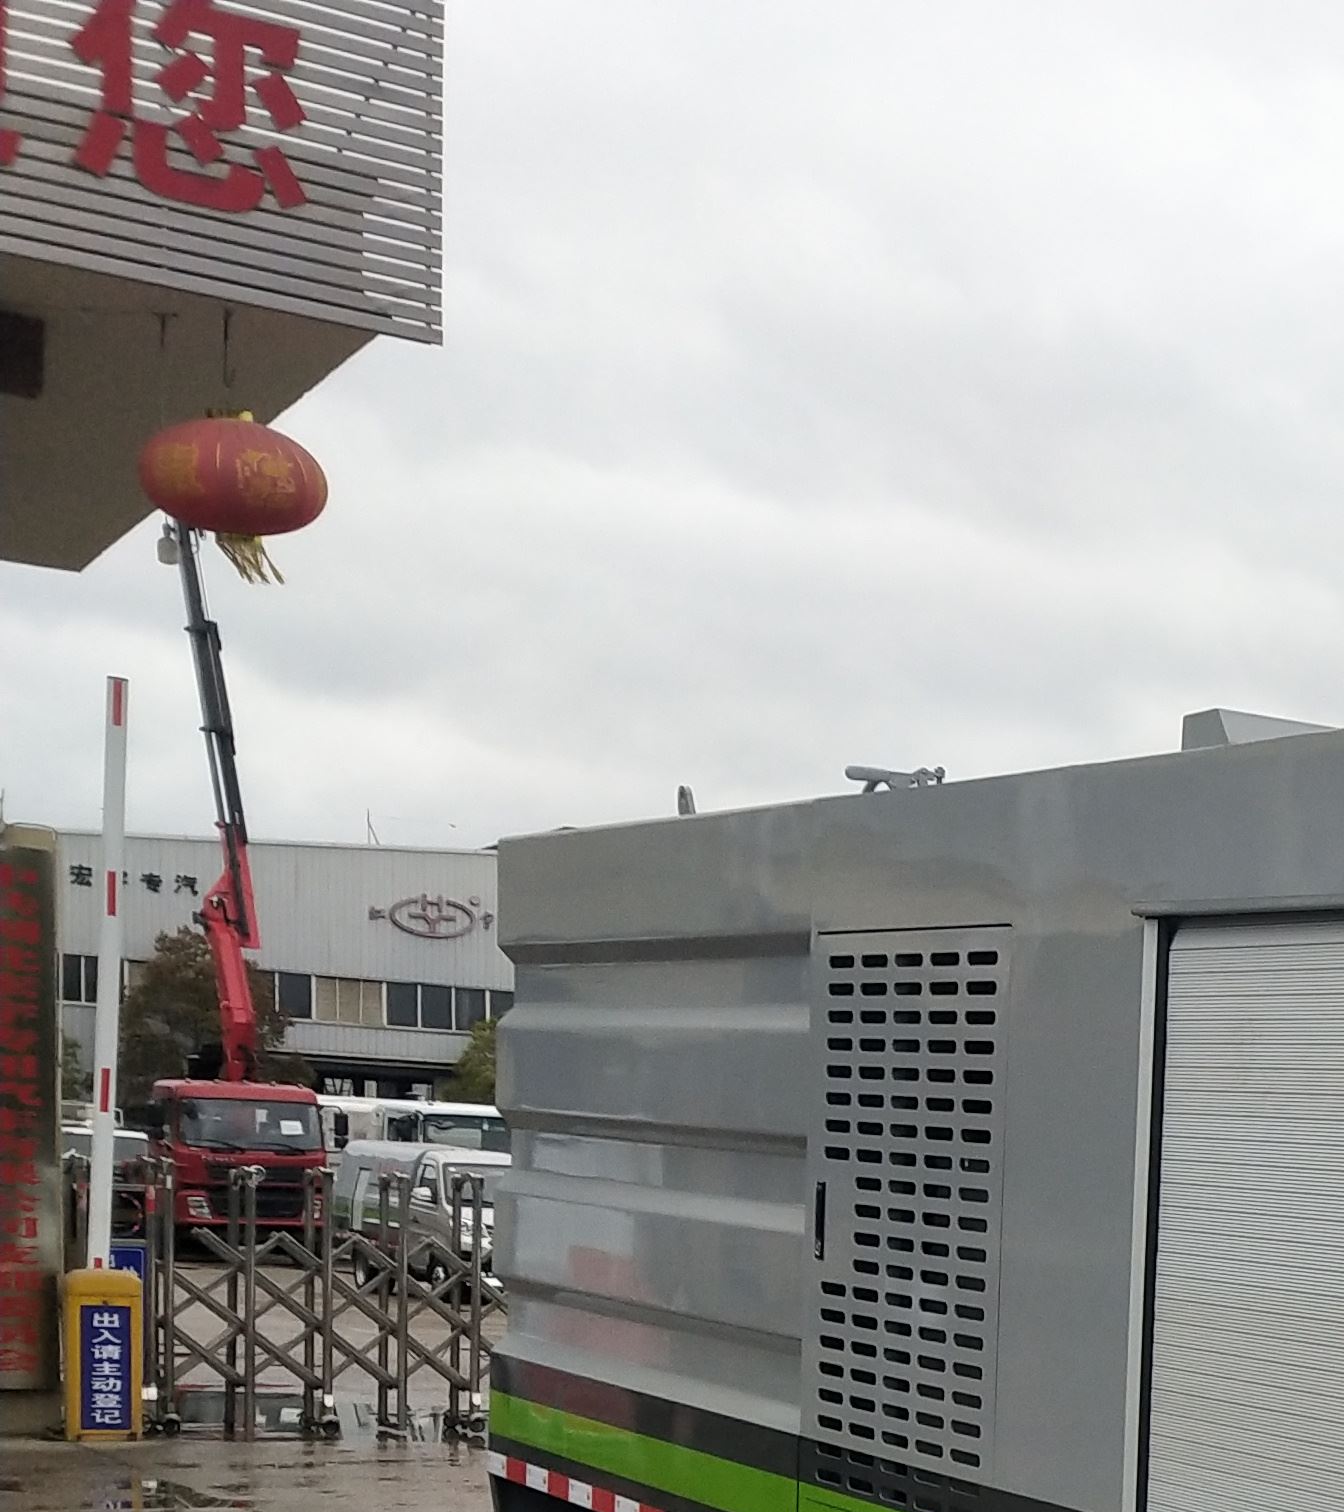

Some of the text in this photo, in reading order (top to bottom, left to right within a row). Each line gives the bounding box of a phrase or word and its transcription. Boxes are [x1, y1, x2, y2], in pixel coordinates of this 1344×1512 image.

[0, 0, 307, 213] 您
[69, 864, 199, 897] 宏专汽
[91, 1311, 122, 1425] 出入请主动登记
